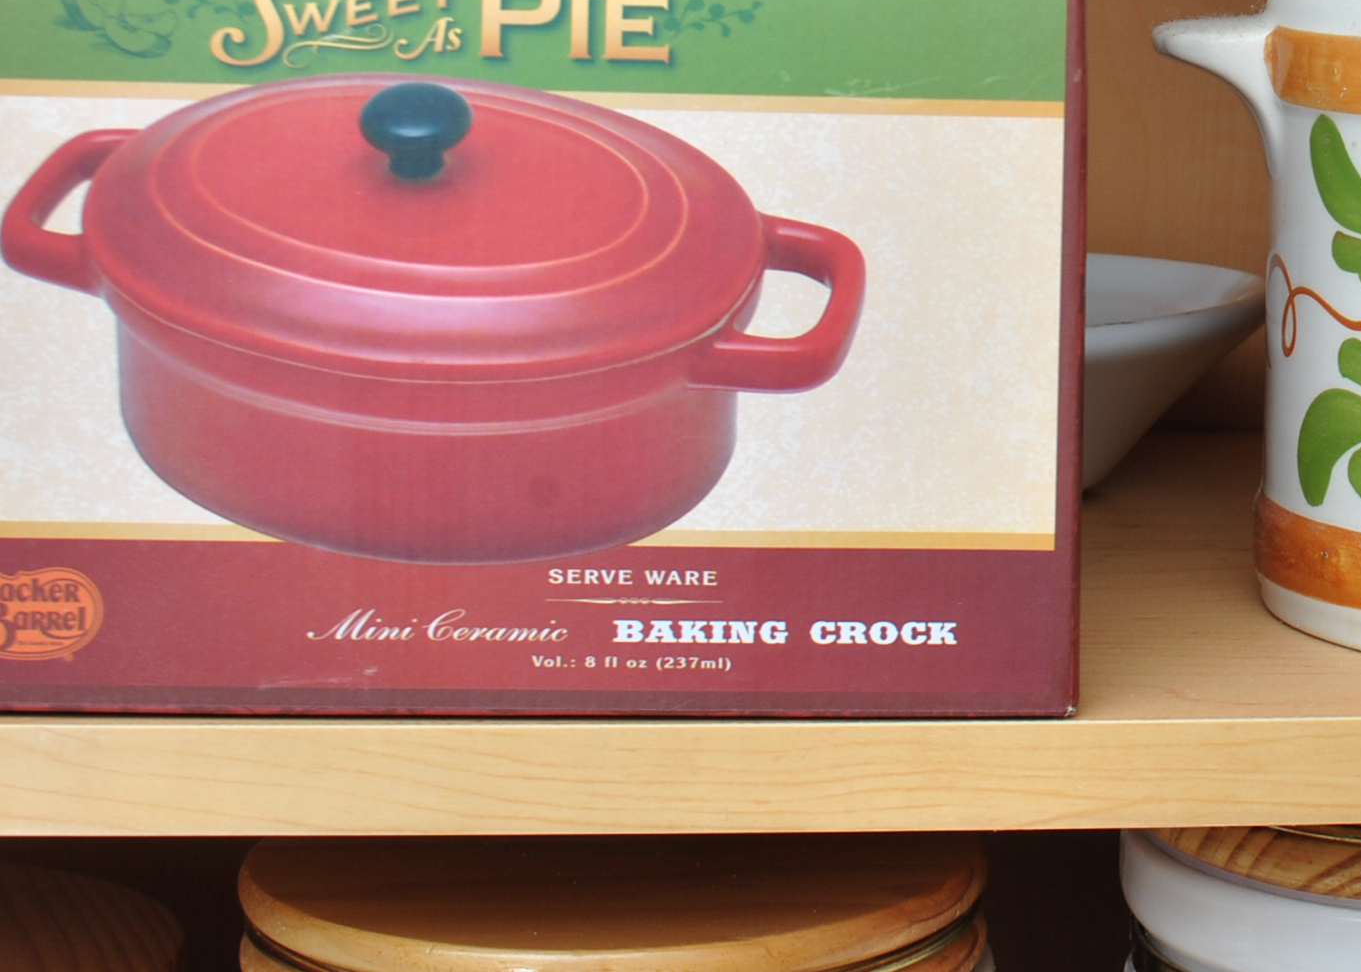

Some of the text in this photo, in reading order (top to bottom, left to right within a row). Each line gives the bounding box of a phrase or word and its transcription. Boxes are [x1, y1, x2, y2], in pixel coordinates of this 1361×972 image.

[547, 568, 718, 587] SERVE WARE
[306, 608, 958, 646] Mini Ceramic BAKING CROCK
[584, 655, 596, 669] 8
[604, 655, 618, 669] fl
[626, 658, 648, 669] oz
[655, 656, 732, 672] (237ml)
